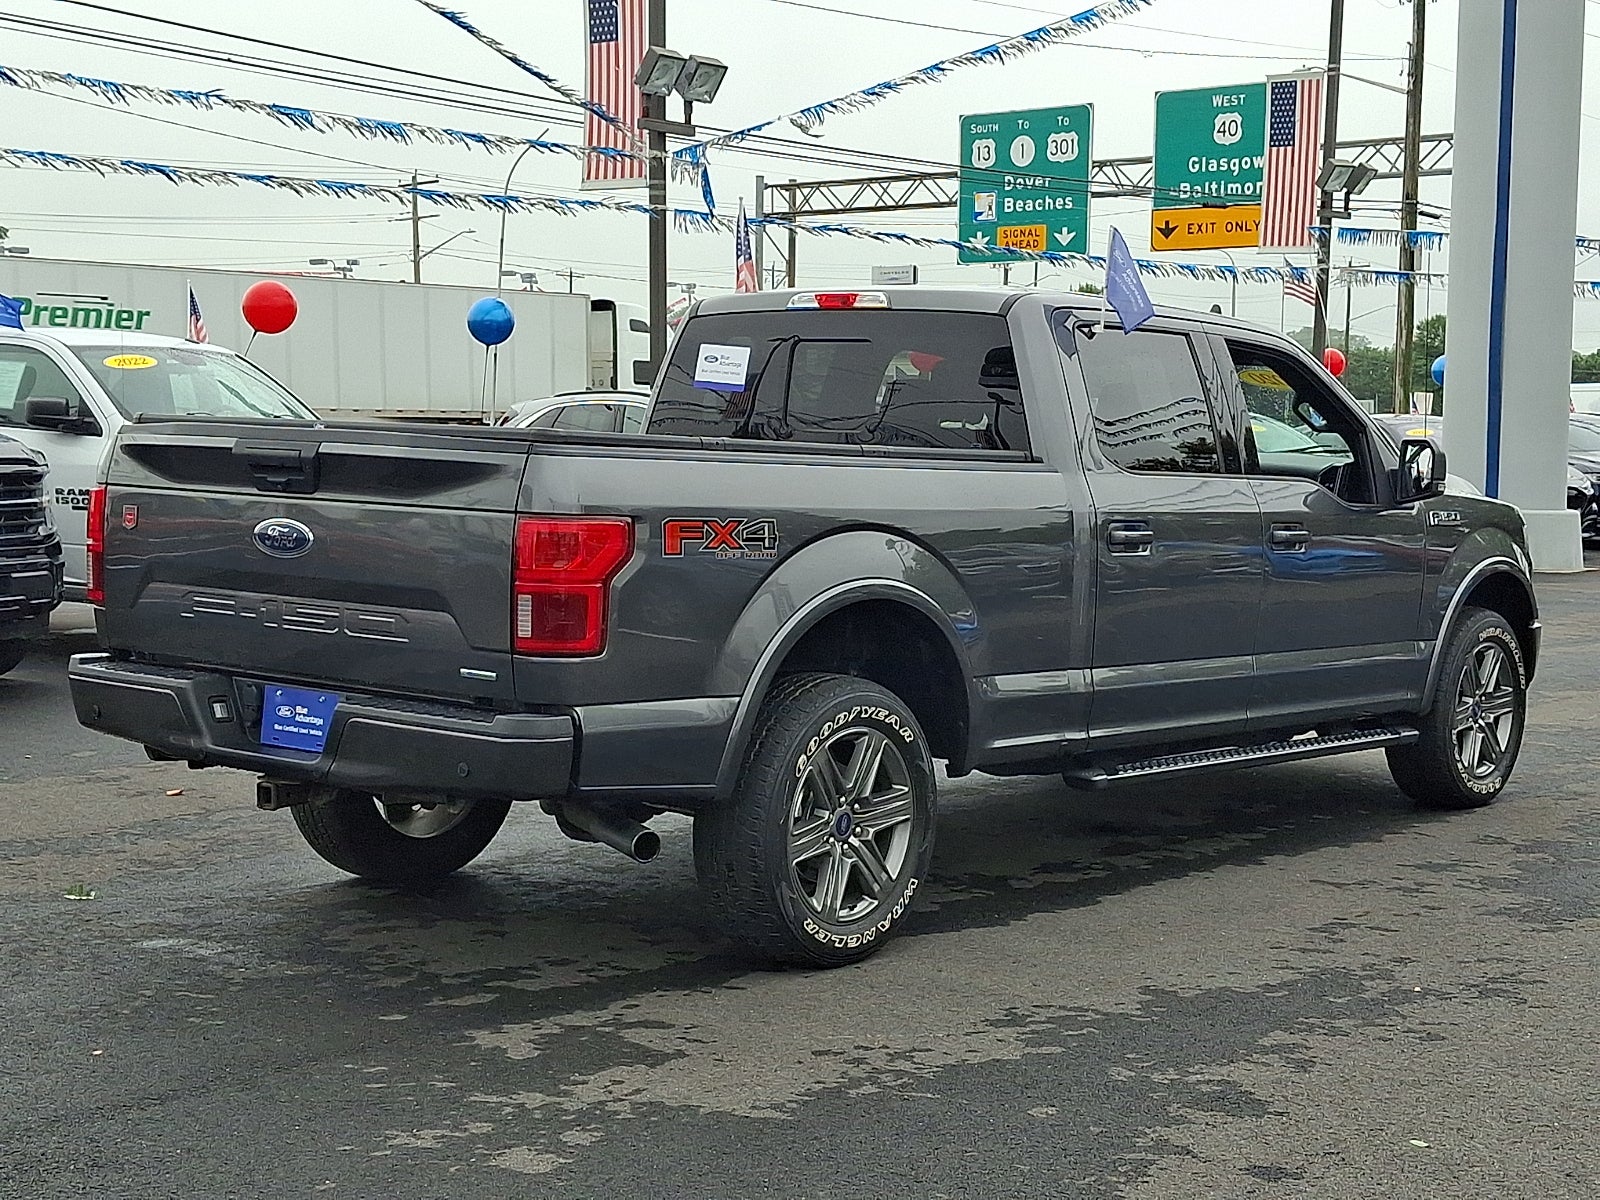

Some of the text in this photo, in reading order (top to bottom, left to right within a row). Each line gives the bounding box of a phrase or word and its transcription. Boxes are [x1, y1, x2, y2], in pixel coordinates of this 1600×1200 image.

[1212, 94, 1246, 107] WEST
[970, 123, 999, 134] SOUTH
[1216, 119, 1239, 138] 40
[976, 144, 992, 162] 13
[1049, 138, 1076, 156] 301
[1188, 155, 1265, 176] Glasgow
[1004, 176, 1052, 191] Dover
[1179, 181, 1263, 198] Baltimor
[1004, 195, 1073, 213] Beaches
[1002, 228, 1041, 239] SIGNAL
[1187, 219, 1262, 235] EXIT ONLY
[1004, 239, 1040, 249] AHEAD
[12, 296, 151, 330] Premier
[114, 357, 149, 367] 2022
[55, 488, 91, 496] RAM
[661, 517, 778, 558] FX4
[796, 706, 914, 777] GOODYEAR
[804, 878, 918, 948] WRANGLER
